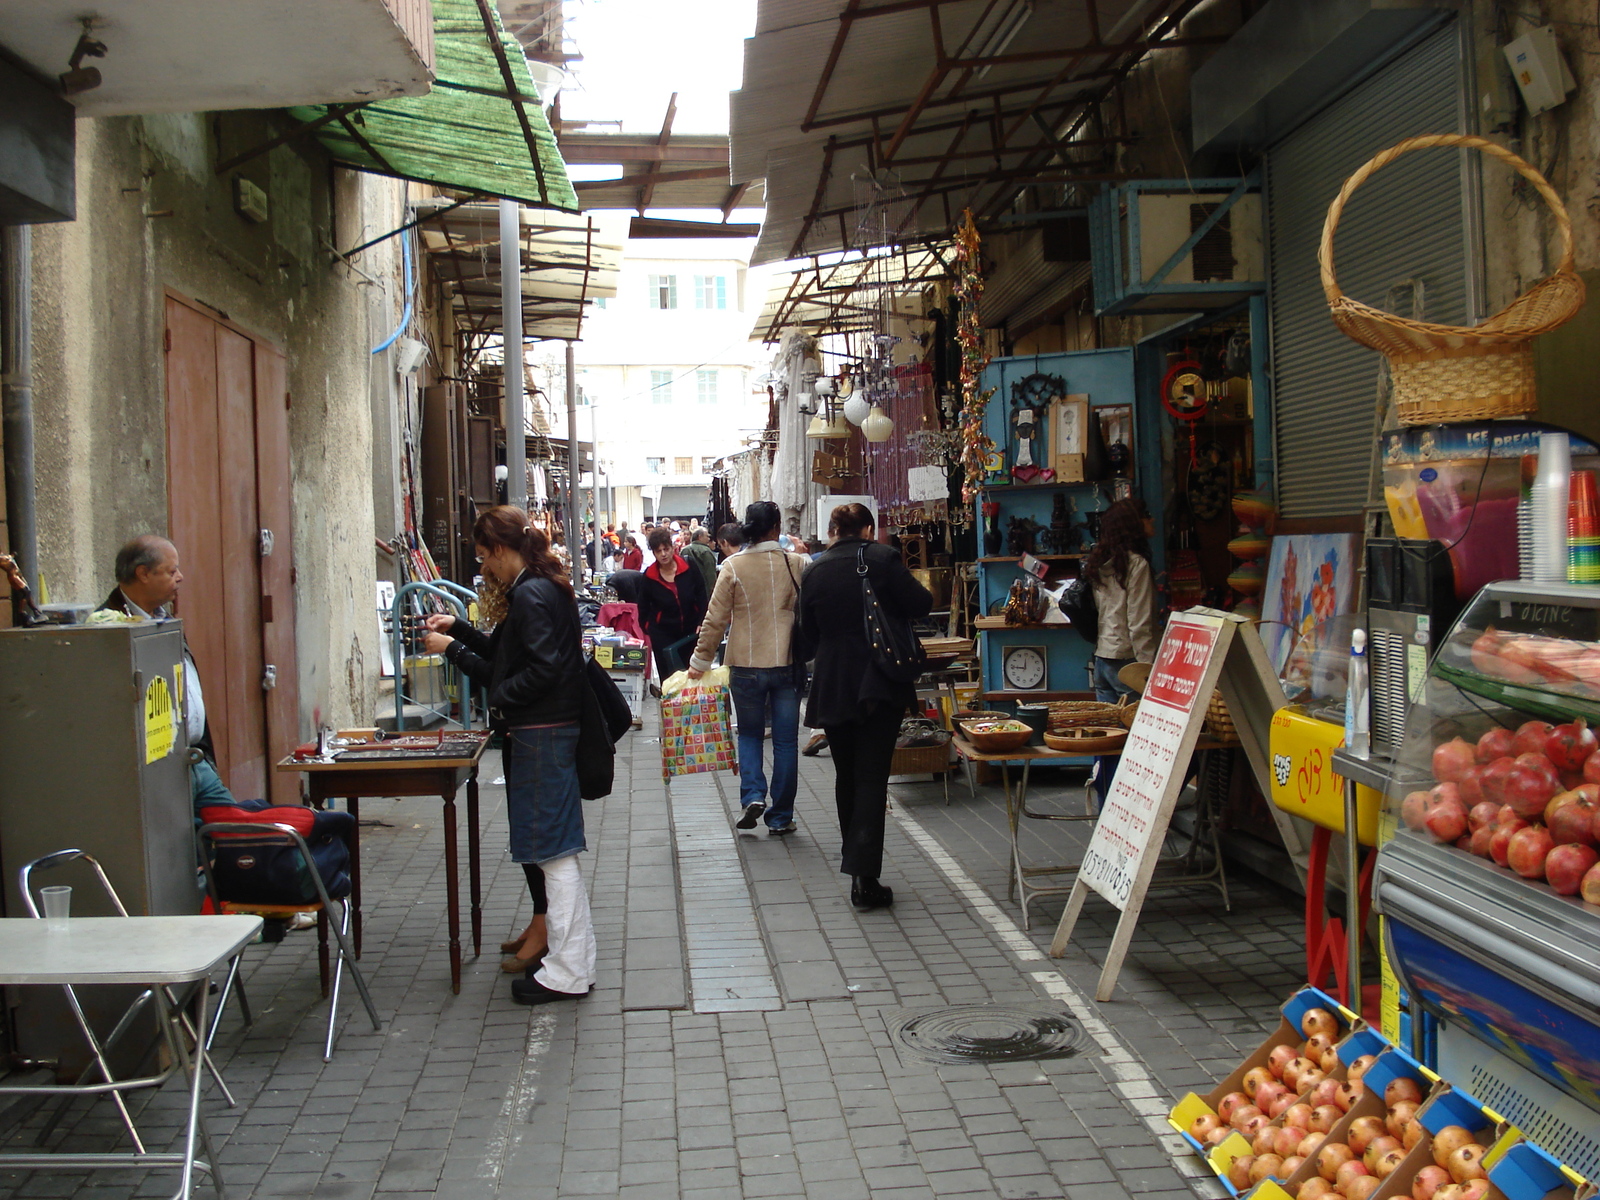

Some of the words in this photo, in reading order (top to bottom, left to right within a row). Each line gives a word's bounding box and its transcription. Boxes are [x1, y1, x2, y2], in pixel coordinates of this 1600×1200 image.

[1467, 430, 1489, 446] ICE
[1162, 638, 1183, 667] יעקב
[1183, 633, 1209, 667] שמואלי
